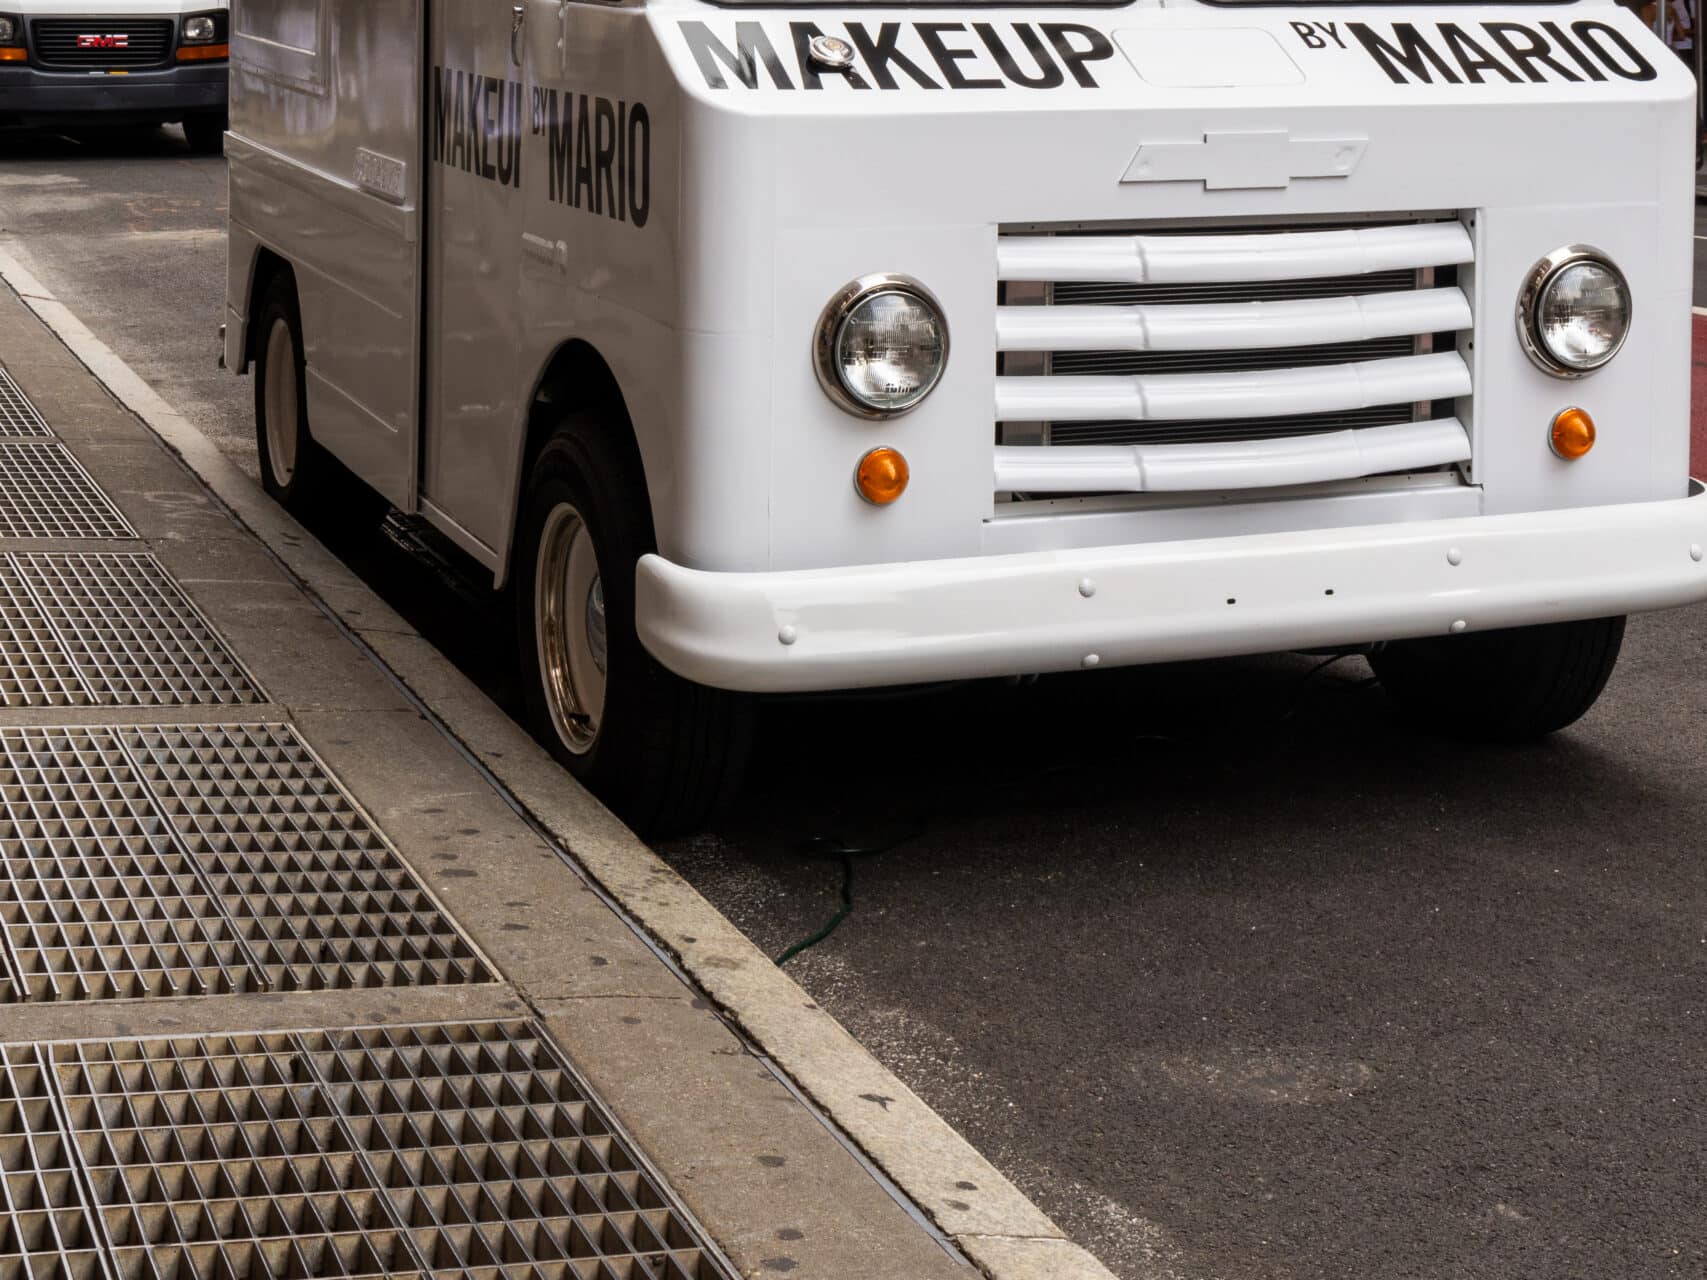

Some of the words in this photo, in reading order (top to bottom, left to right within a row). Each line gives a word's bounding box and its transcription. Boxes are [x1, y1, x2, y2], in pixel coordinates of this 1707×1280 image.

[77, 34, 129, 48] GMC
[676, 20, 1115, 90] MAKEUP
[1288, 22, 1348, 49] BY
[1344, 20, 1658, 84] MARIO
[532, 85, 548, 137] BY
[549, 89, 650, 228] MARIO
